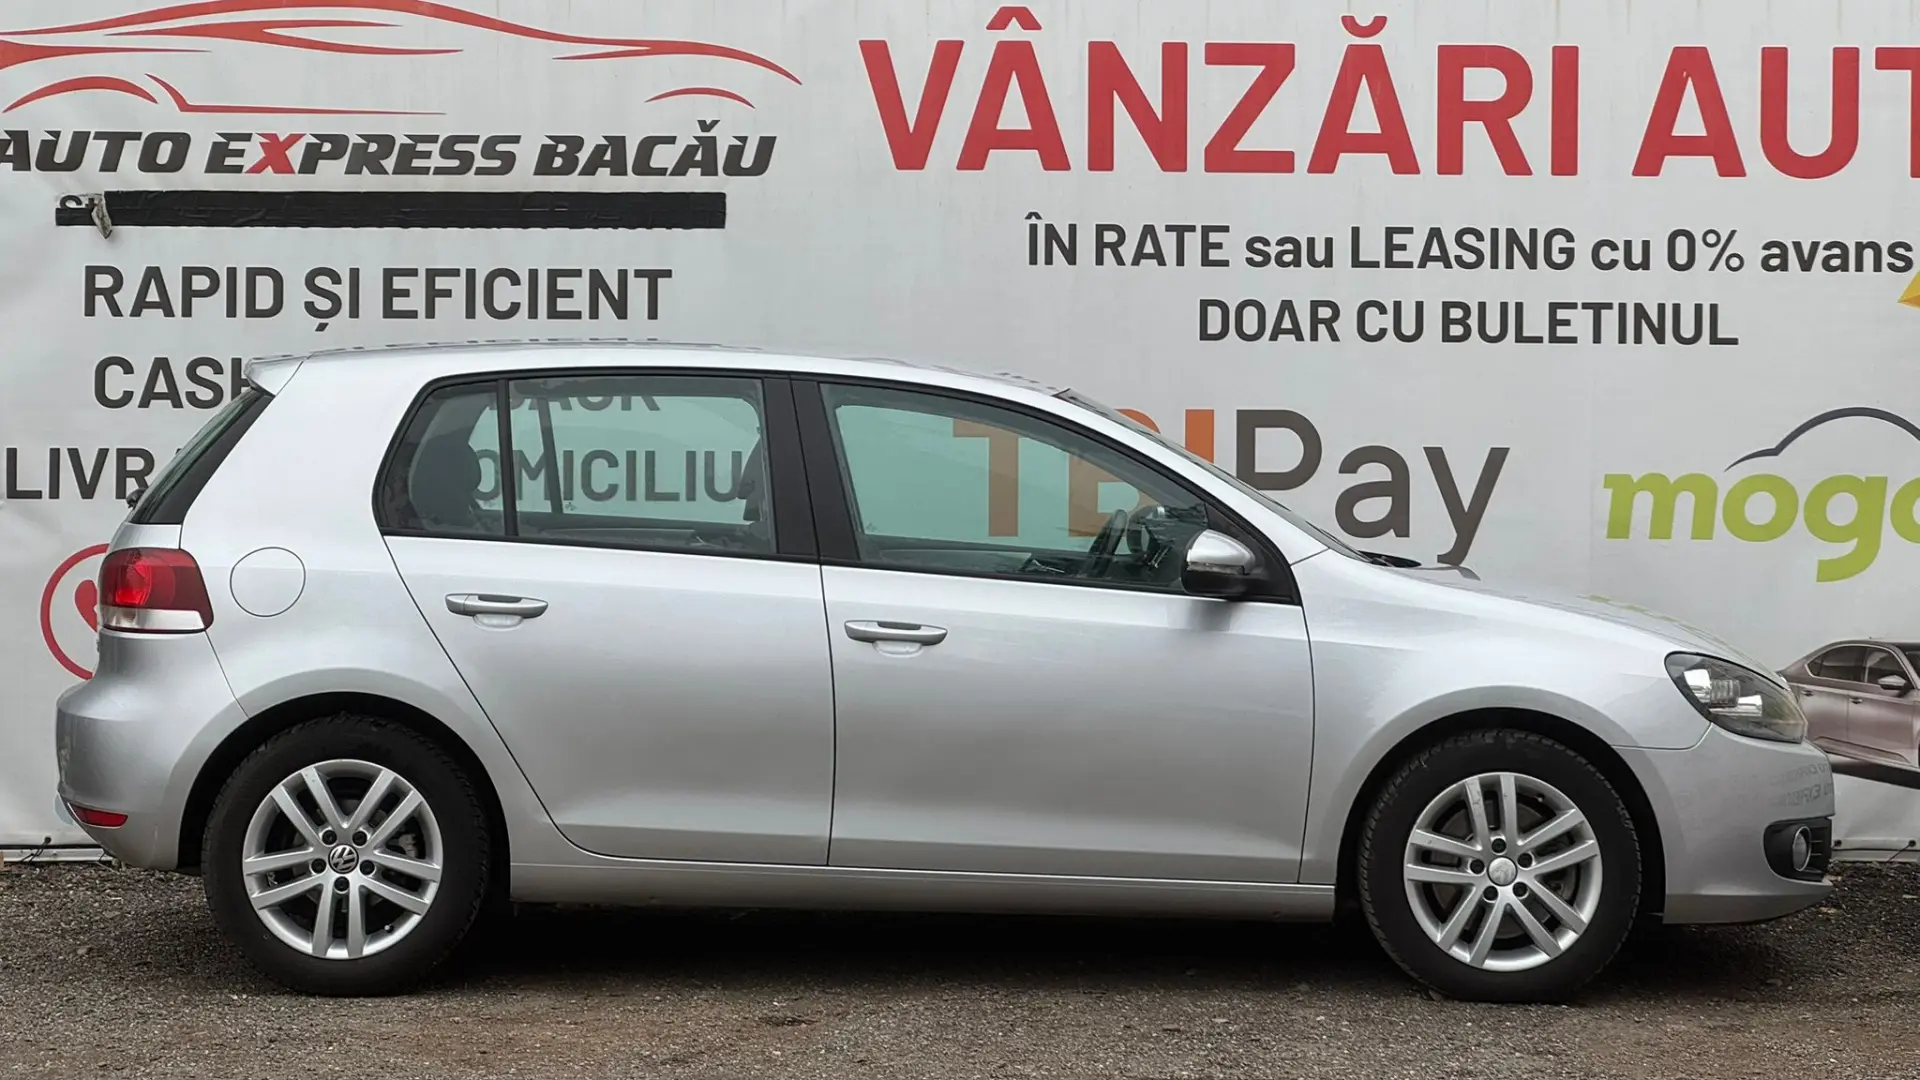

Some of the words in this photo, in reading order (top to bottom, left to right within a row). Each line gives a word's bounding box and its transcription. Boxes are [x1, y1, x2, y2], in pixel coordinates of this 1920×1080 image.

[860, 6, 1580, 177] VÂNZĂRI
[0, 129, 192, 174] AUTO
[203, 132, 522, 176] EXPRESS
[532, 119, 777, 177] BACĂU
[1025, 211, 1077, 266] ÎN
[1095, 223, 1230, 268] RATE
[1245, 235, 1334, 269] sau
[1350, 226, 1575, 271] LEASING
[1591, 238, 1651, 271] cu
[1667, 228, 1745, 273] 0%
[1760, 240, 1914, 274] avans
[84, 265, 284, 318] RAPID
[303, 266, 360, 332] ȘI
[382, 267, 673, 320] EFICIENT
[1199, 298, 1341, 343] DOAR
[1356, 299, 1424, 343] CU
[1441, 300, 1739, 346] BULETINUL
[6, 447, 182, 500] LIVR
[473, 449, 743, 502] OMICILIU
